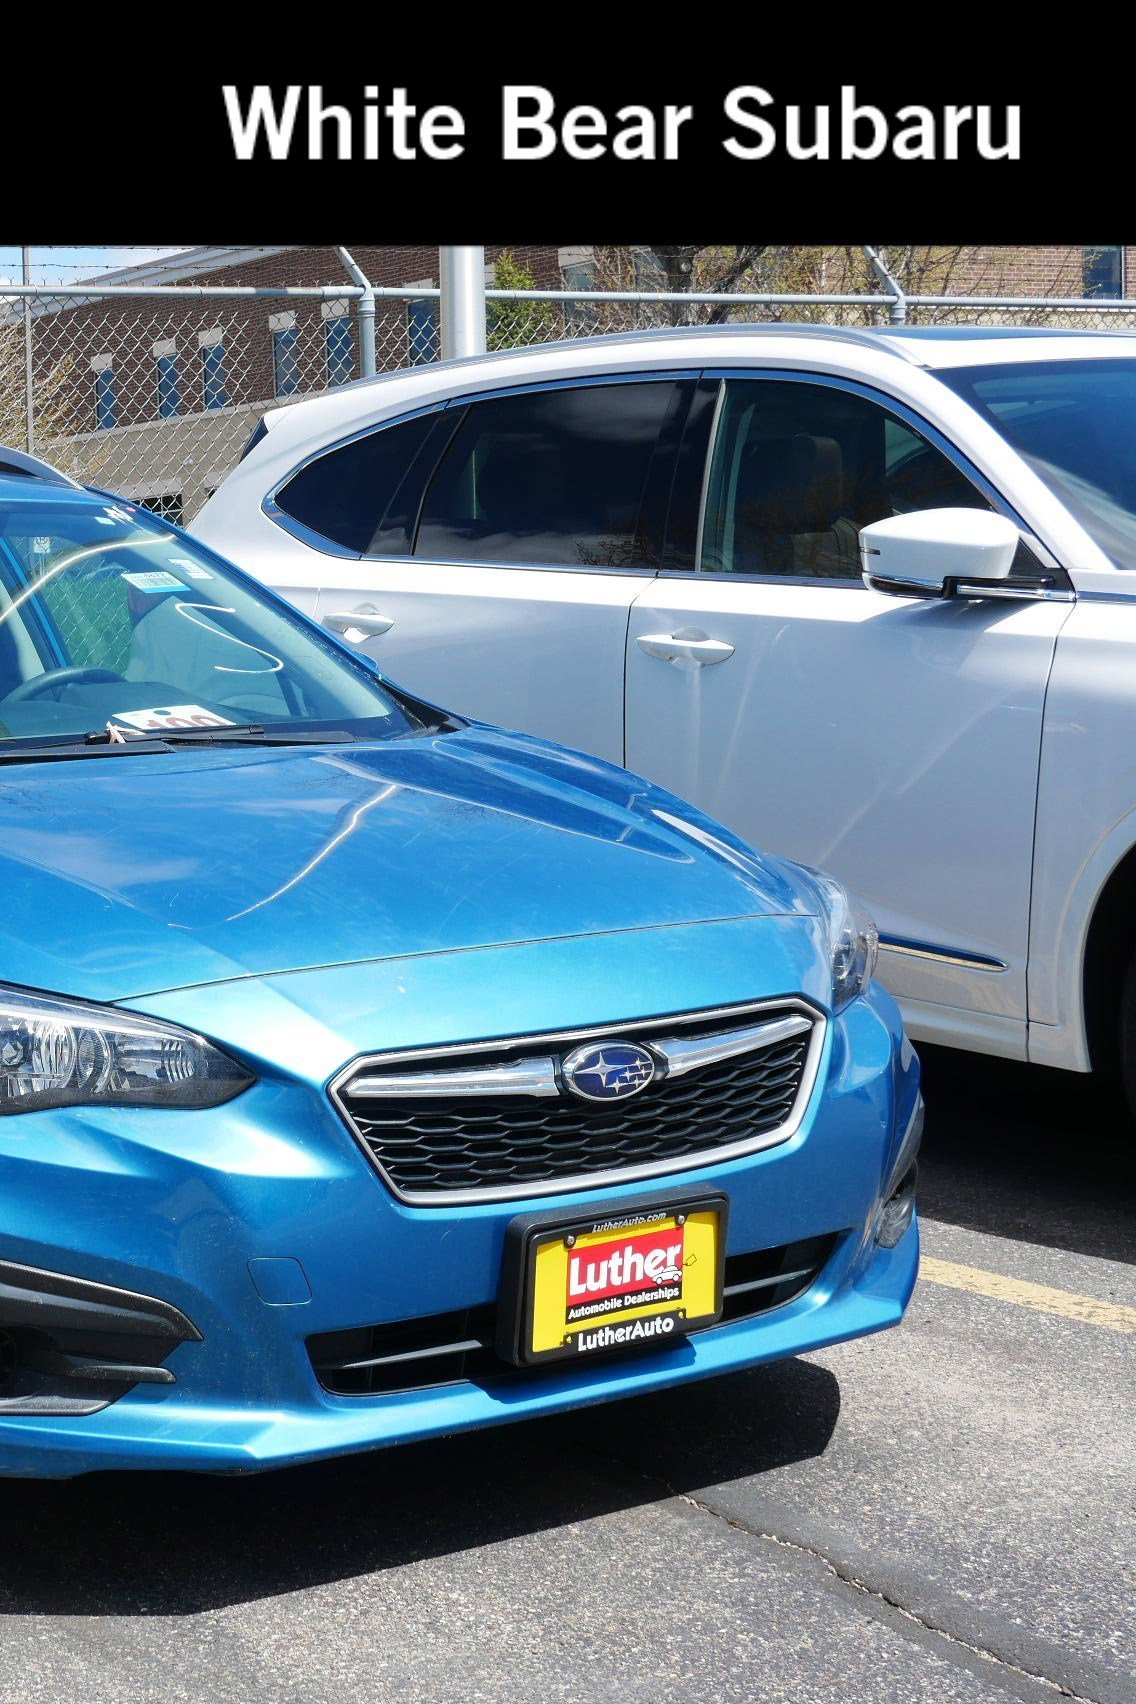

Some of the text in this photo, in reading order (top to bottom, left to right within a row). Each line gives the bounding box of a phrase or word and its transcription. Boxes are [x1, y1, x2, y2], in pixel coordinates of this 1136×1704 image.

[592, 1212, 666, 1233] LutherAuto.com
[569, 1245, 681, 1296] Luther
[567, 1286, 680, 1320] Automobile Dealerships
[577, 1316, 675, 1352] LutherAuto
